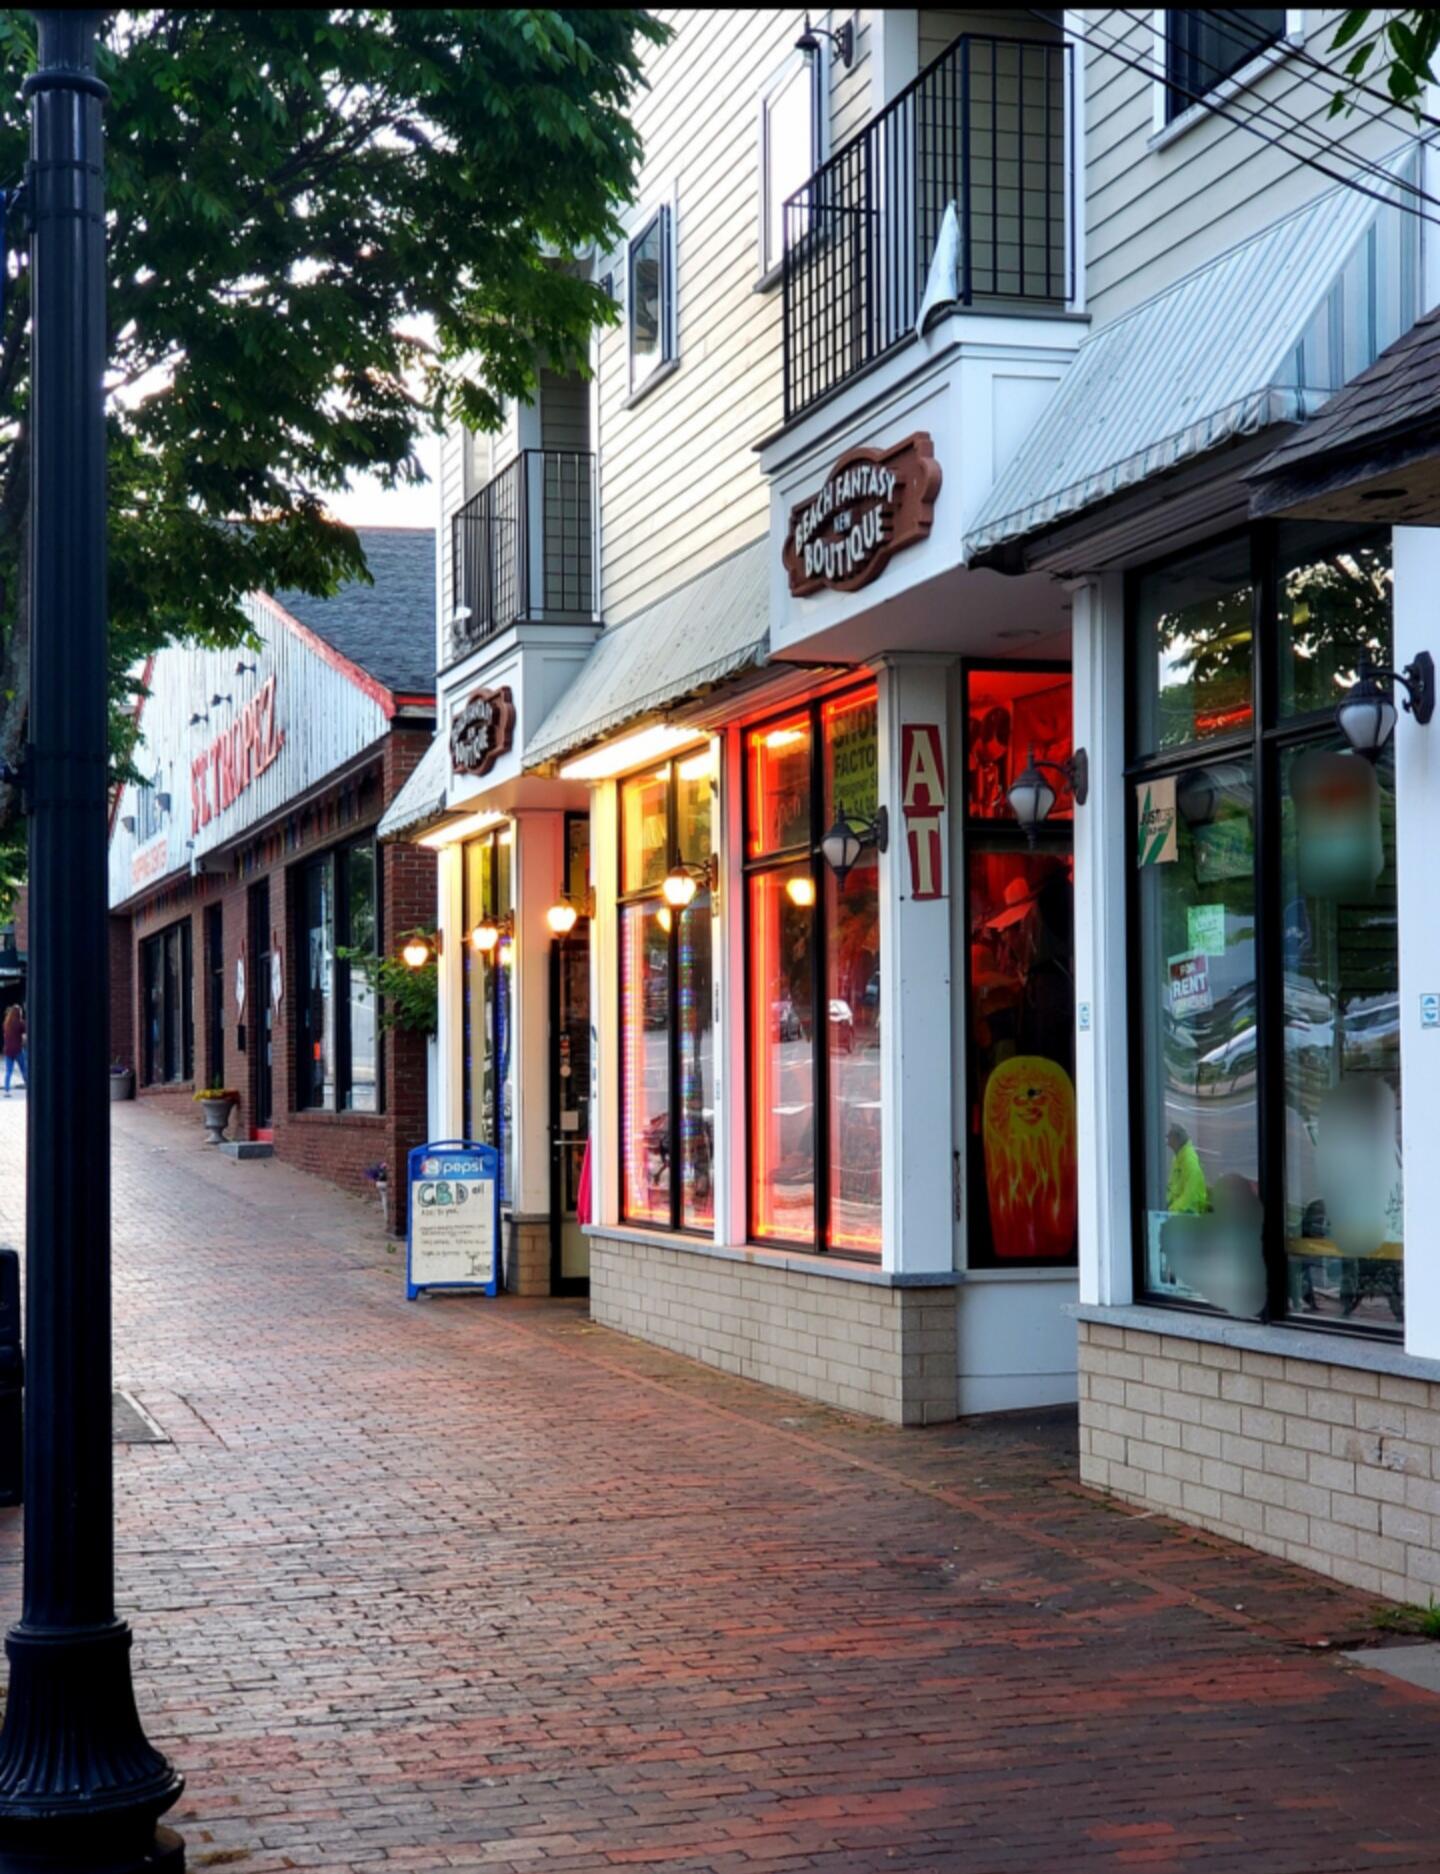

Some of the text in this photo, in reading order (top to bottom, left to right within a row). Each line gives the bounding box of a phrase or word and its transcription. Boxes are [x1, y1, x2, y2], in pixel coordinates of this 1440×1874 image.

[835, 464, 895, 503] FANTASY
[804, 503, 885, 579] BOUTIQUE
[1172, 972, 1206, 1000] RENT
[443, 1158, 484, 1175] pepsi
[418, 1181, 469, 1207] CBD
